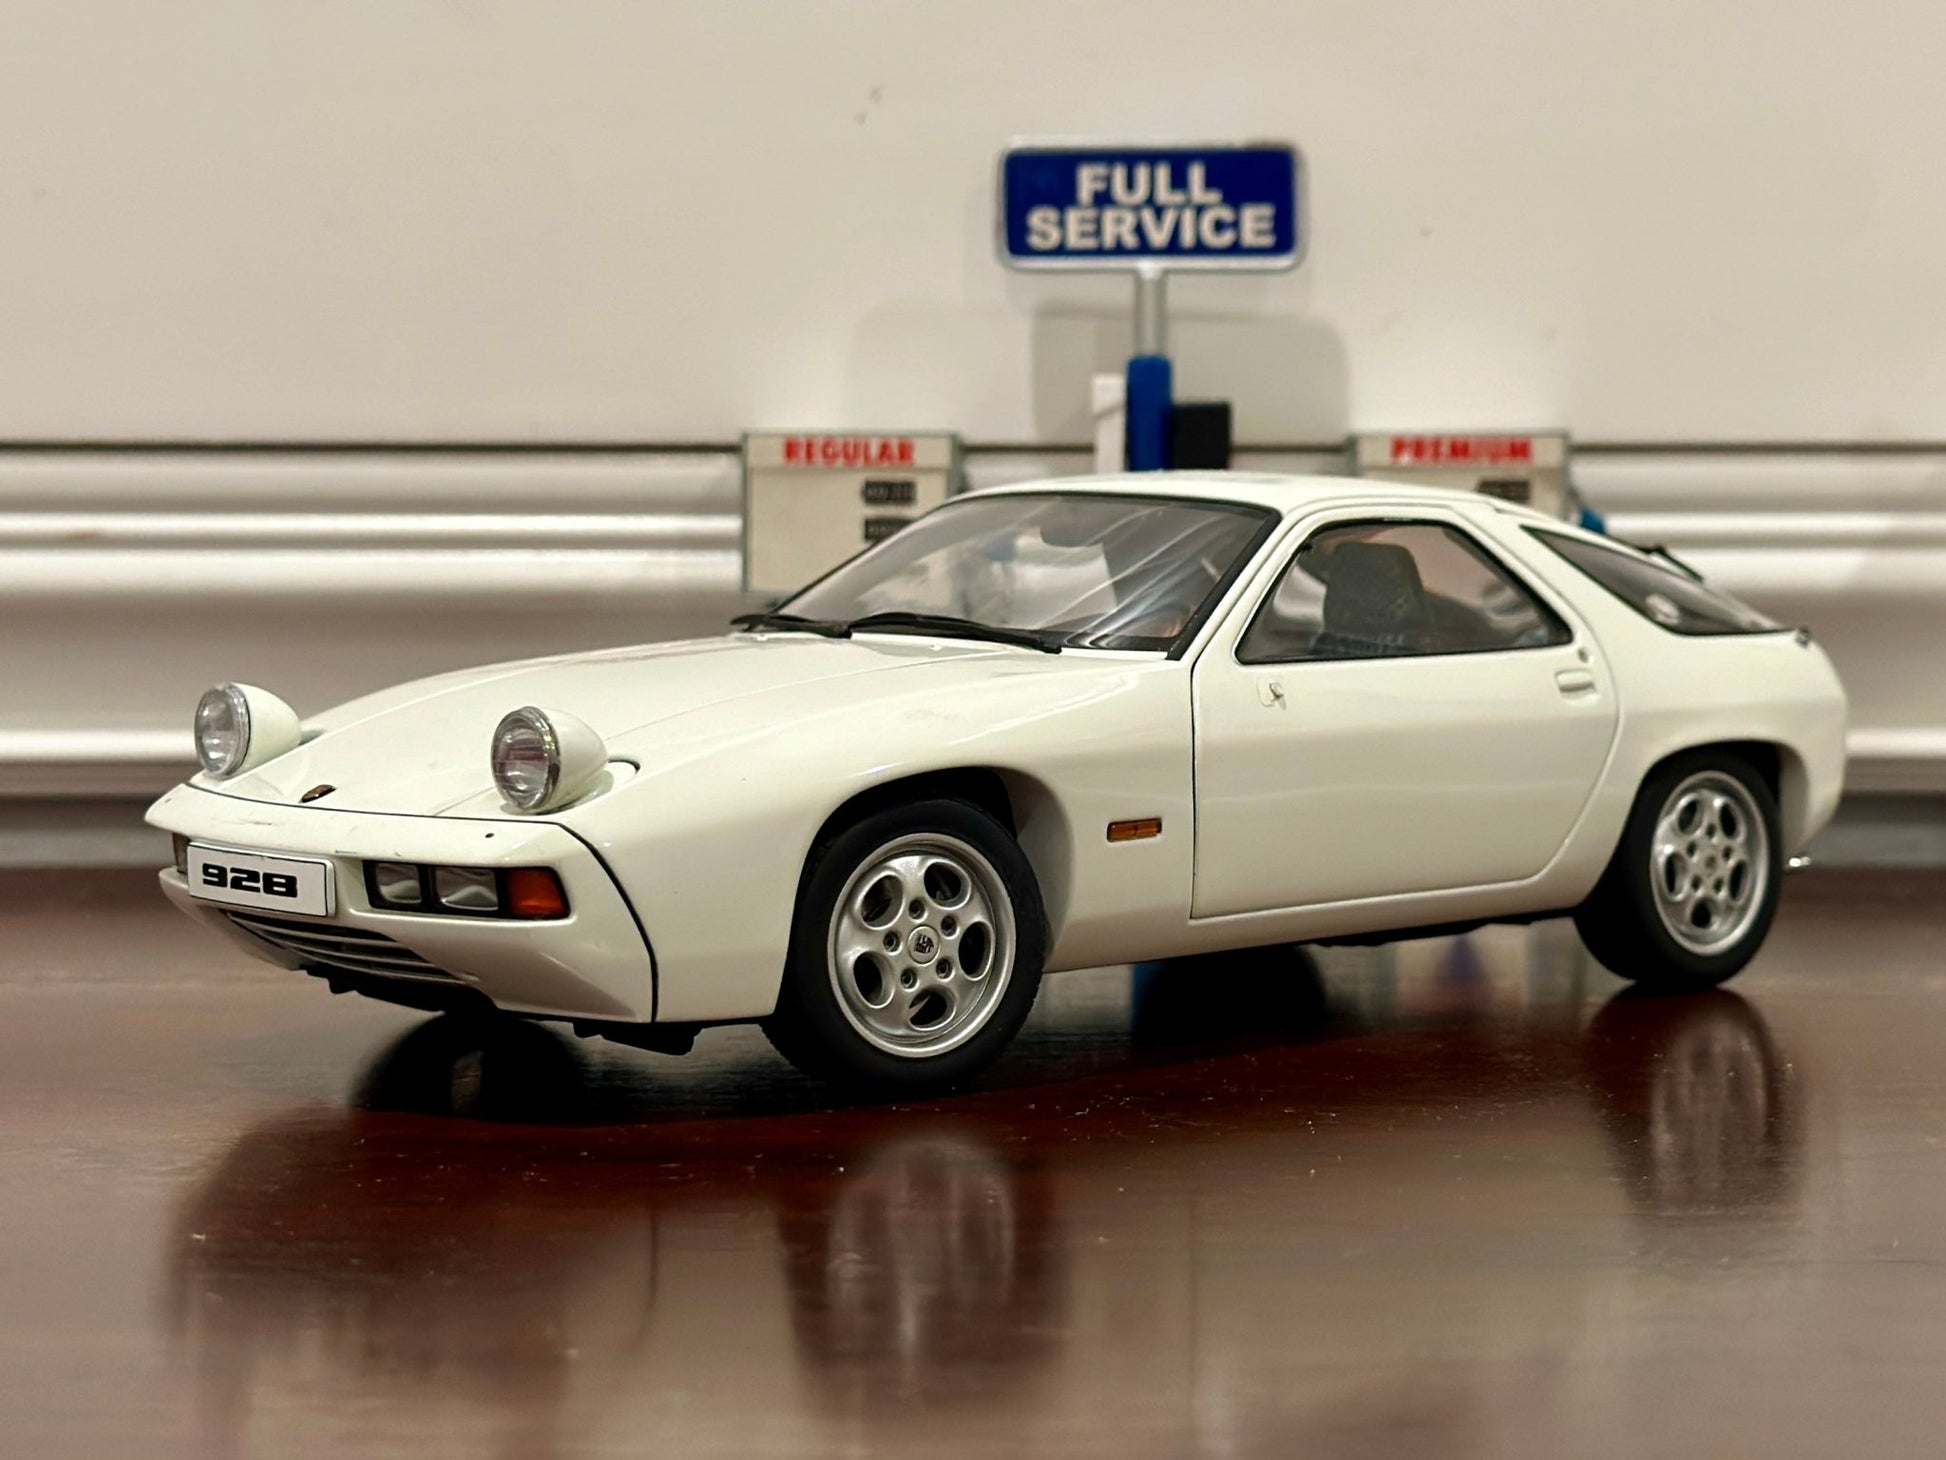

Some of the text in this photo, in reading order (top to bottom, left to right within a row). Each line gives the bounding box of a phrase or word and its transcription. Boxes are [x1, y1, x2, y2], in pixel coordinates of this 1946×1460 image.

[1076, 162, 1223, 206] FULL
[1026, 204, 1276, 250] SERVICE
[783, 437, 915, 466] REGULAR
[1391, 436, 1532, 464] PREMIUM
[202, 862, 298, 898] 928
